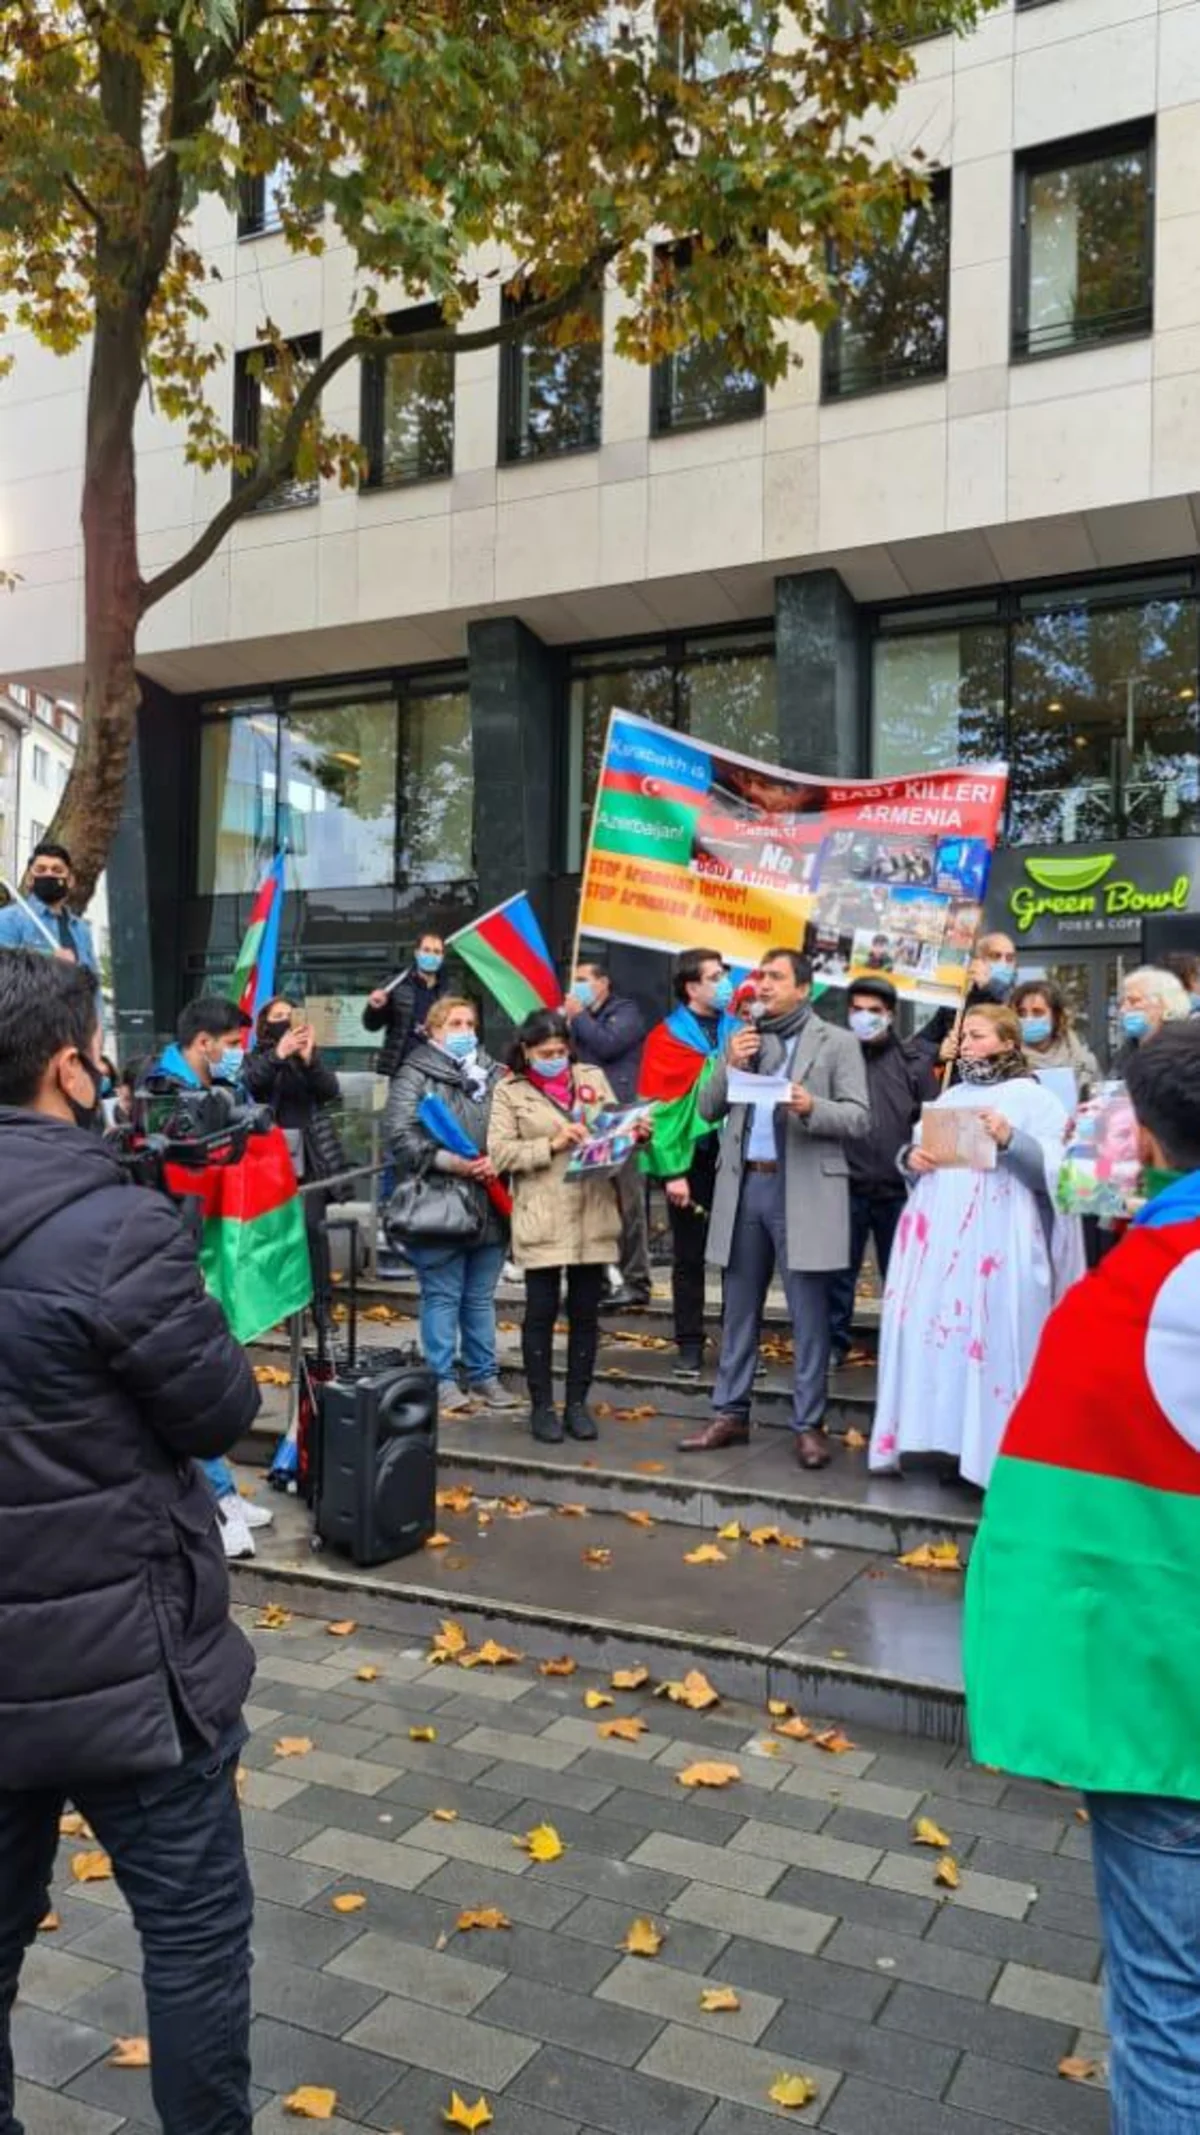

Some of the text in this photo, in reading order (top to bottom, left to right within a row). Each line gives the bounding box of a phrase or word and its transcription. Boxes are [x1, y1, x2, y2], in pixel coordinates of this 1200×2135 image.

[830, 785, 896, 802] BABY
[856, 804, 962, 828] ARMENIA
[1009, 875, 1189, 932] Green Bowl
